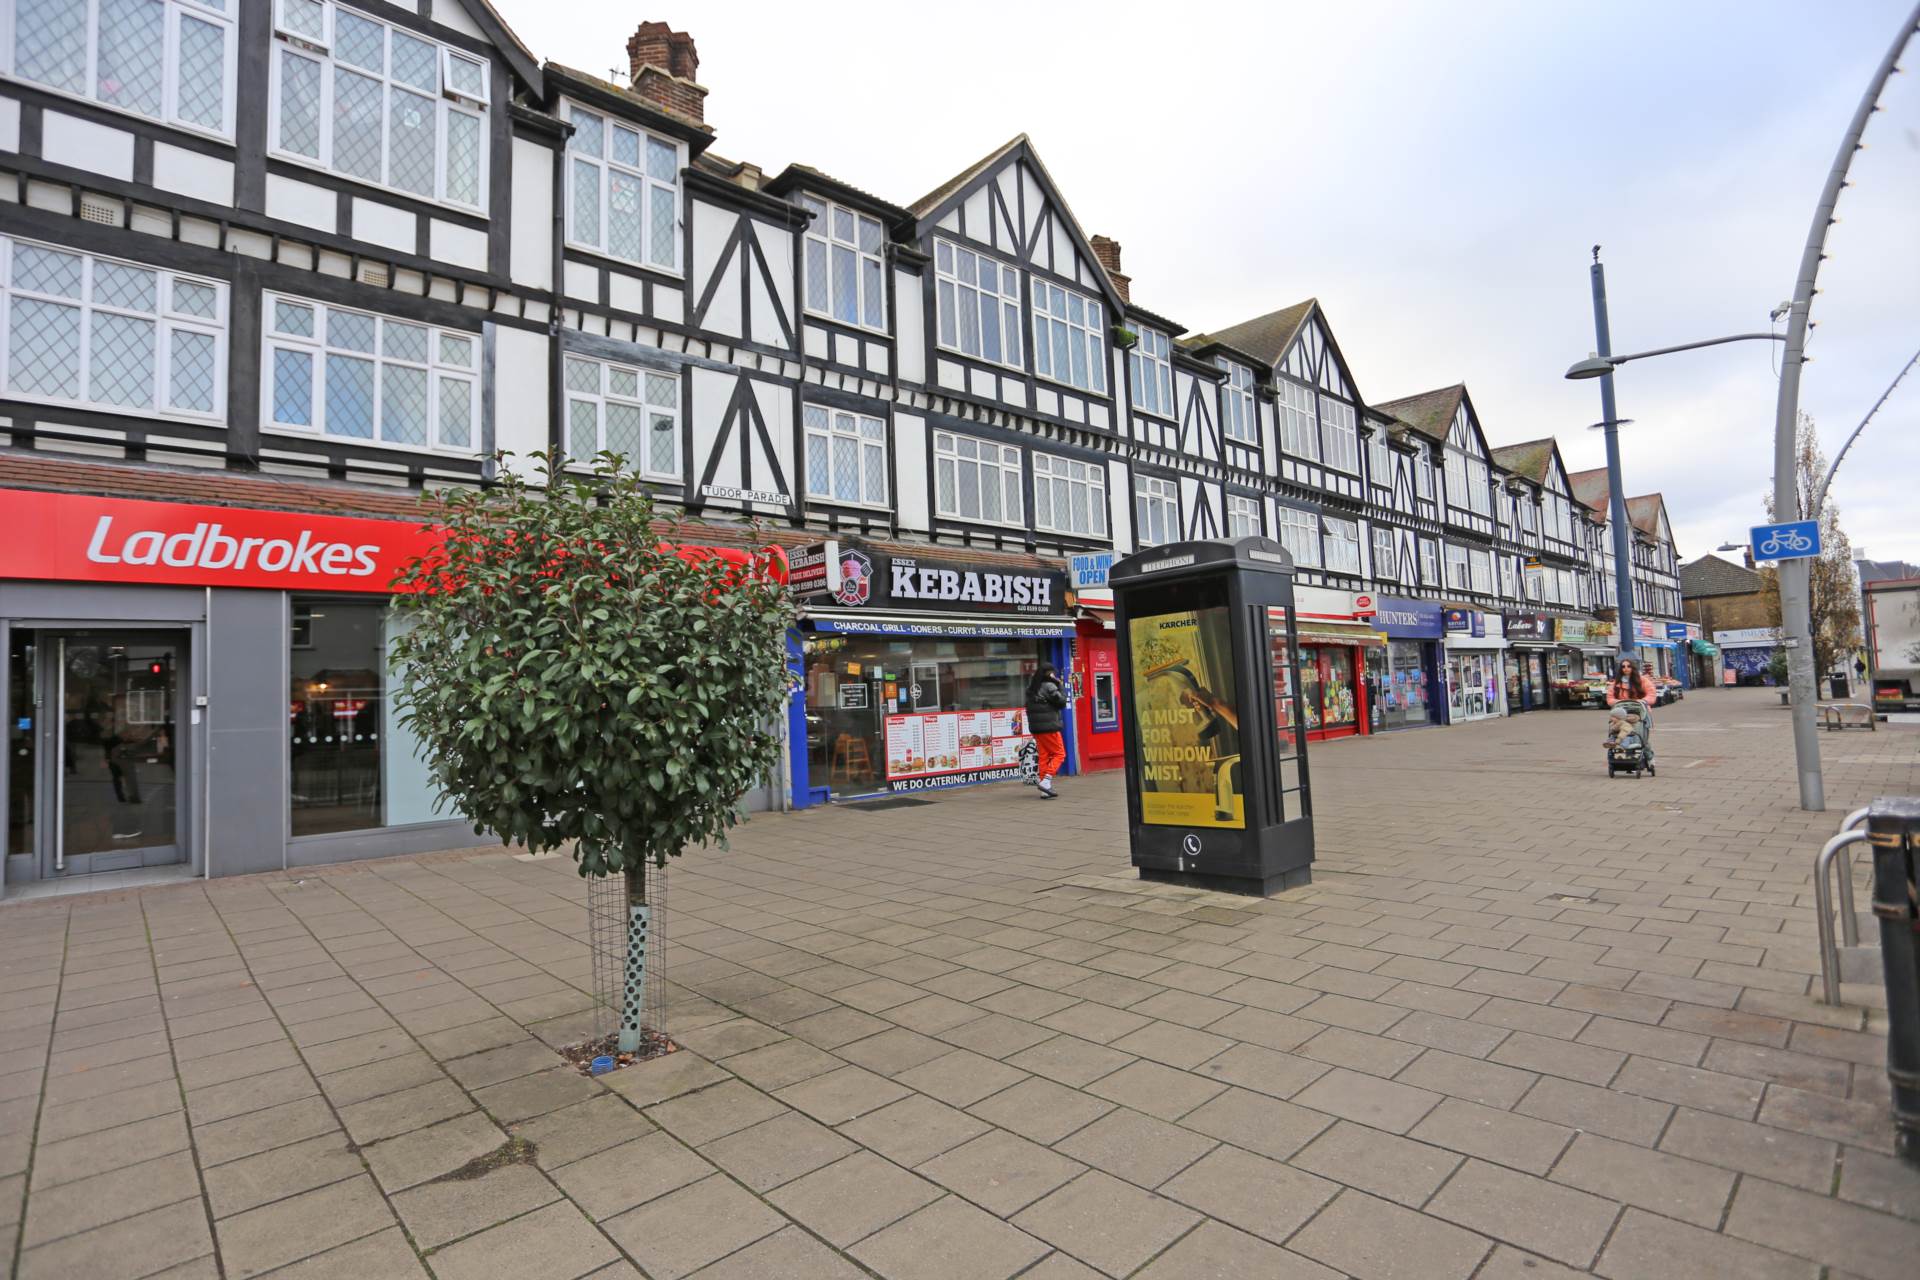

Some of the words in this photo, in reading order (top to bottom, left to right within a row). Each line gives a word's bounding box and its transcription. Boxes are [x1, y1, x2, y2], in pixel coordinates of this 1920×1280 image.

[704, 486, 742, 499] TUDOR
[747, 491, 788, 504] PARADE
[87, 516, 380, 576] Ladbrokes
[789, 548, 808, 560] ESSEX
[789, 553, 825, 569] KEBABISH
[891, 557, 916, 567] ESSEX
[1073, 556, 1089, 571] FOOD
[1090, 558, 1094, 570] &
[803, 566, 826, 578] DELIVERY
[1079, 571, 1106, 584] OPEN
[890, 565, 1051, 606] KEBABISH
[1380, 611, 1417, 625] HUNTERS
[833, 621, 881, 632] CHARCOAL
[881, 624, 906, 633] GRILL
[948, 626, 977, 635] CURRYS
[981, 627, 1013, 636] KEBABAS
[1017, 628, 1034, 636] FREE
[1034, 628, 1063, 636] DELIVERY
[1142, 711, 1152, 725] A
[1155, 708, 1195, 725] MUST
[1143, 728, 1171, 743] FOR
[1143, 746, 1211, 762] WINDOW
[1144, 765, 1183, 781] MIST.
[893, 781, 908, 791] WE
[909, 779, 923, 789] DO
[925, 774, 966, 788] CATERING
[967, 772, 978, 782] AT
